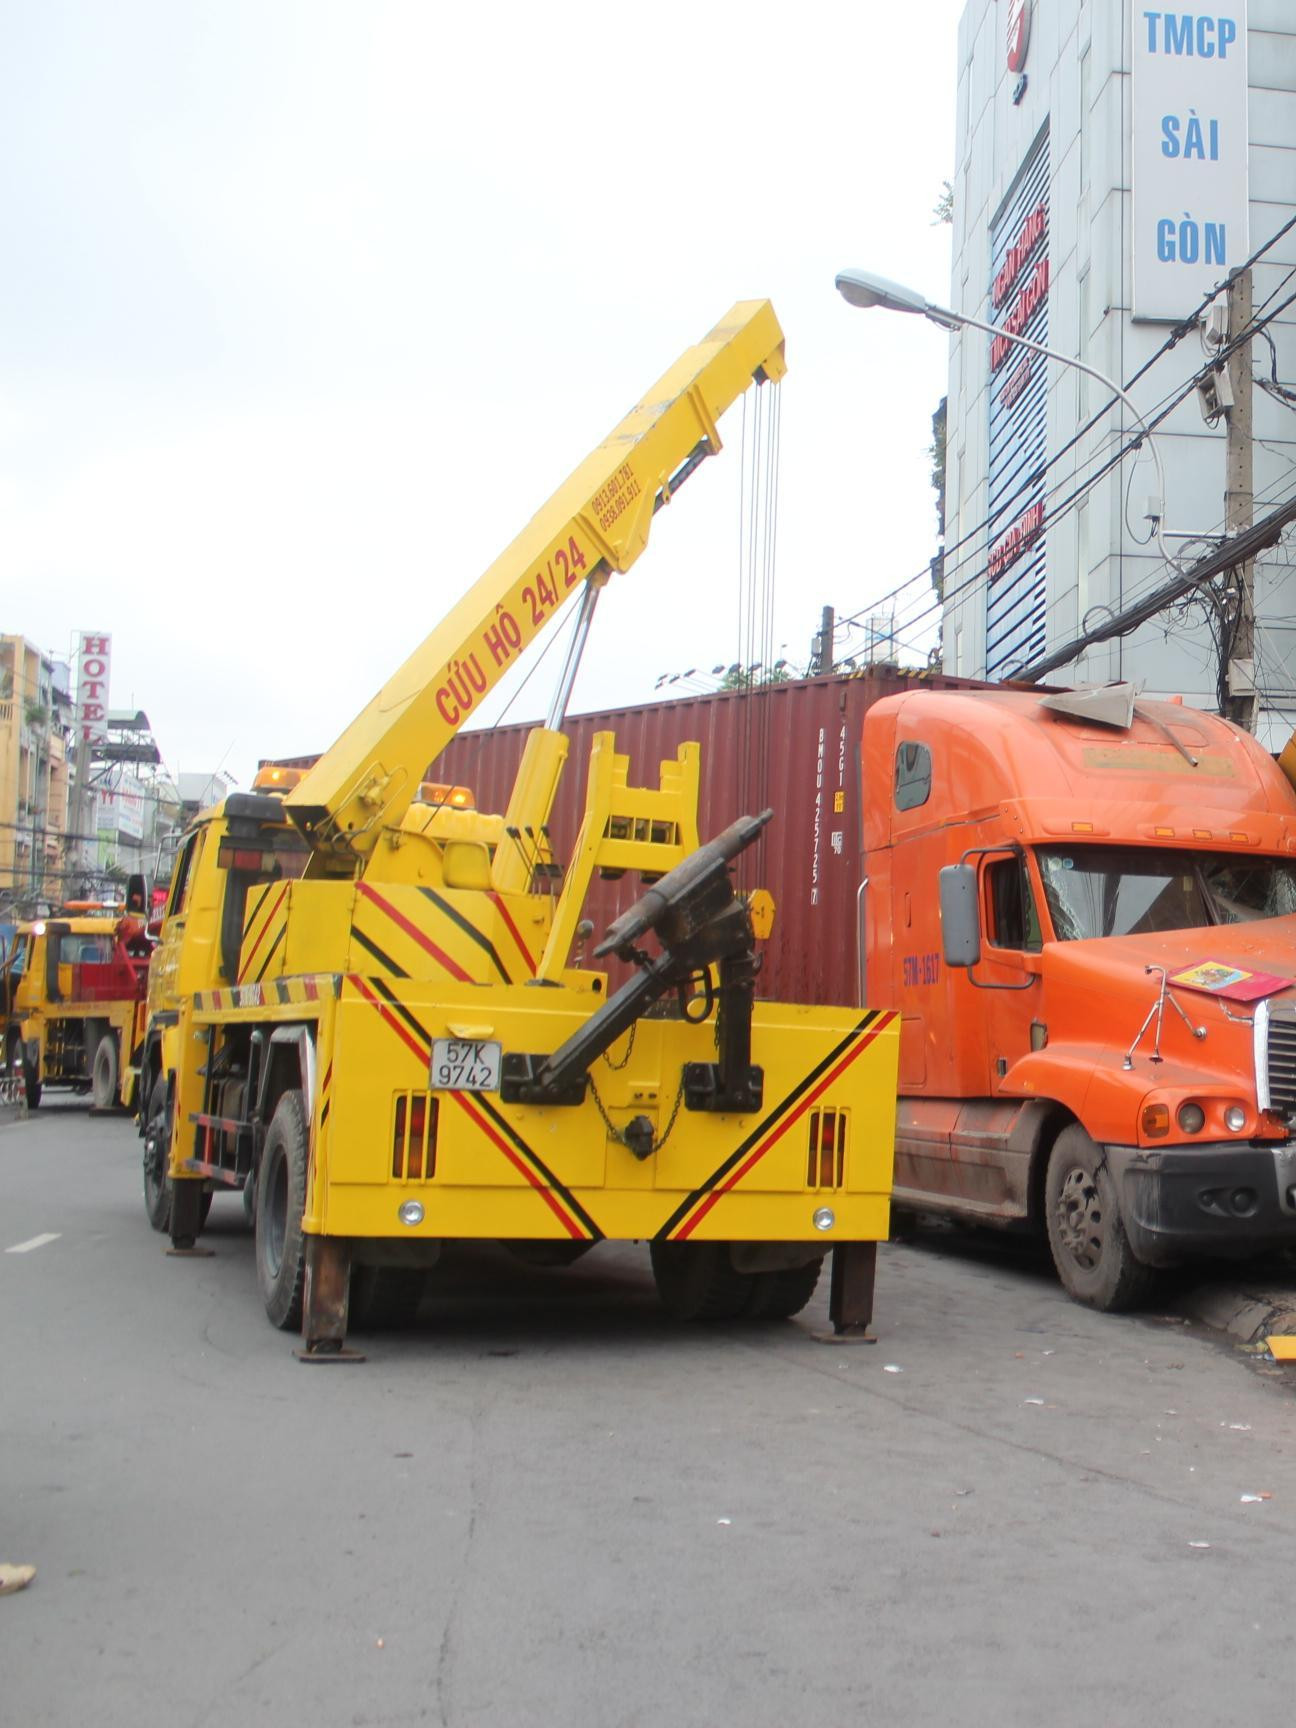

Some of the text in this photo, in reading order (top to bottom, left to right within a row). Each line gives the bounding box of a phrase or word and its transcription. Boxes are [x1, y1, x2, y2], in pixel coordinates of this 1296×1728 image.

[1143, 11, 1237, 59] TMCP
[1161, 108, 1219, 161] SÀI
[1156, 211, 1227, 266] GÒN
[435, 535, 587, 726] CỨU HỘ 24/24
[82, 636, 109, 746] HOTEL
[439, 1065, 492, 1087] 9742
[447, 1042, 486, 1065] 57K
